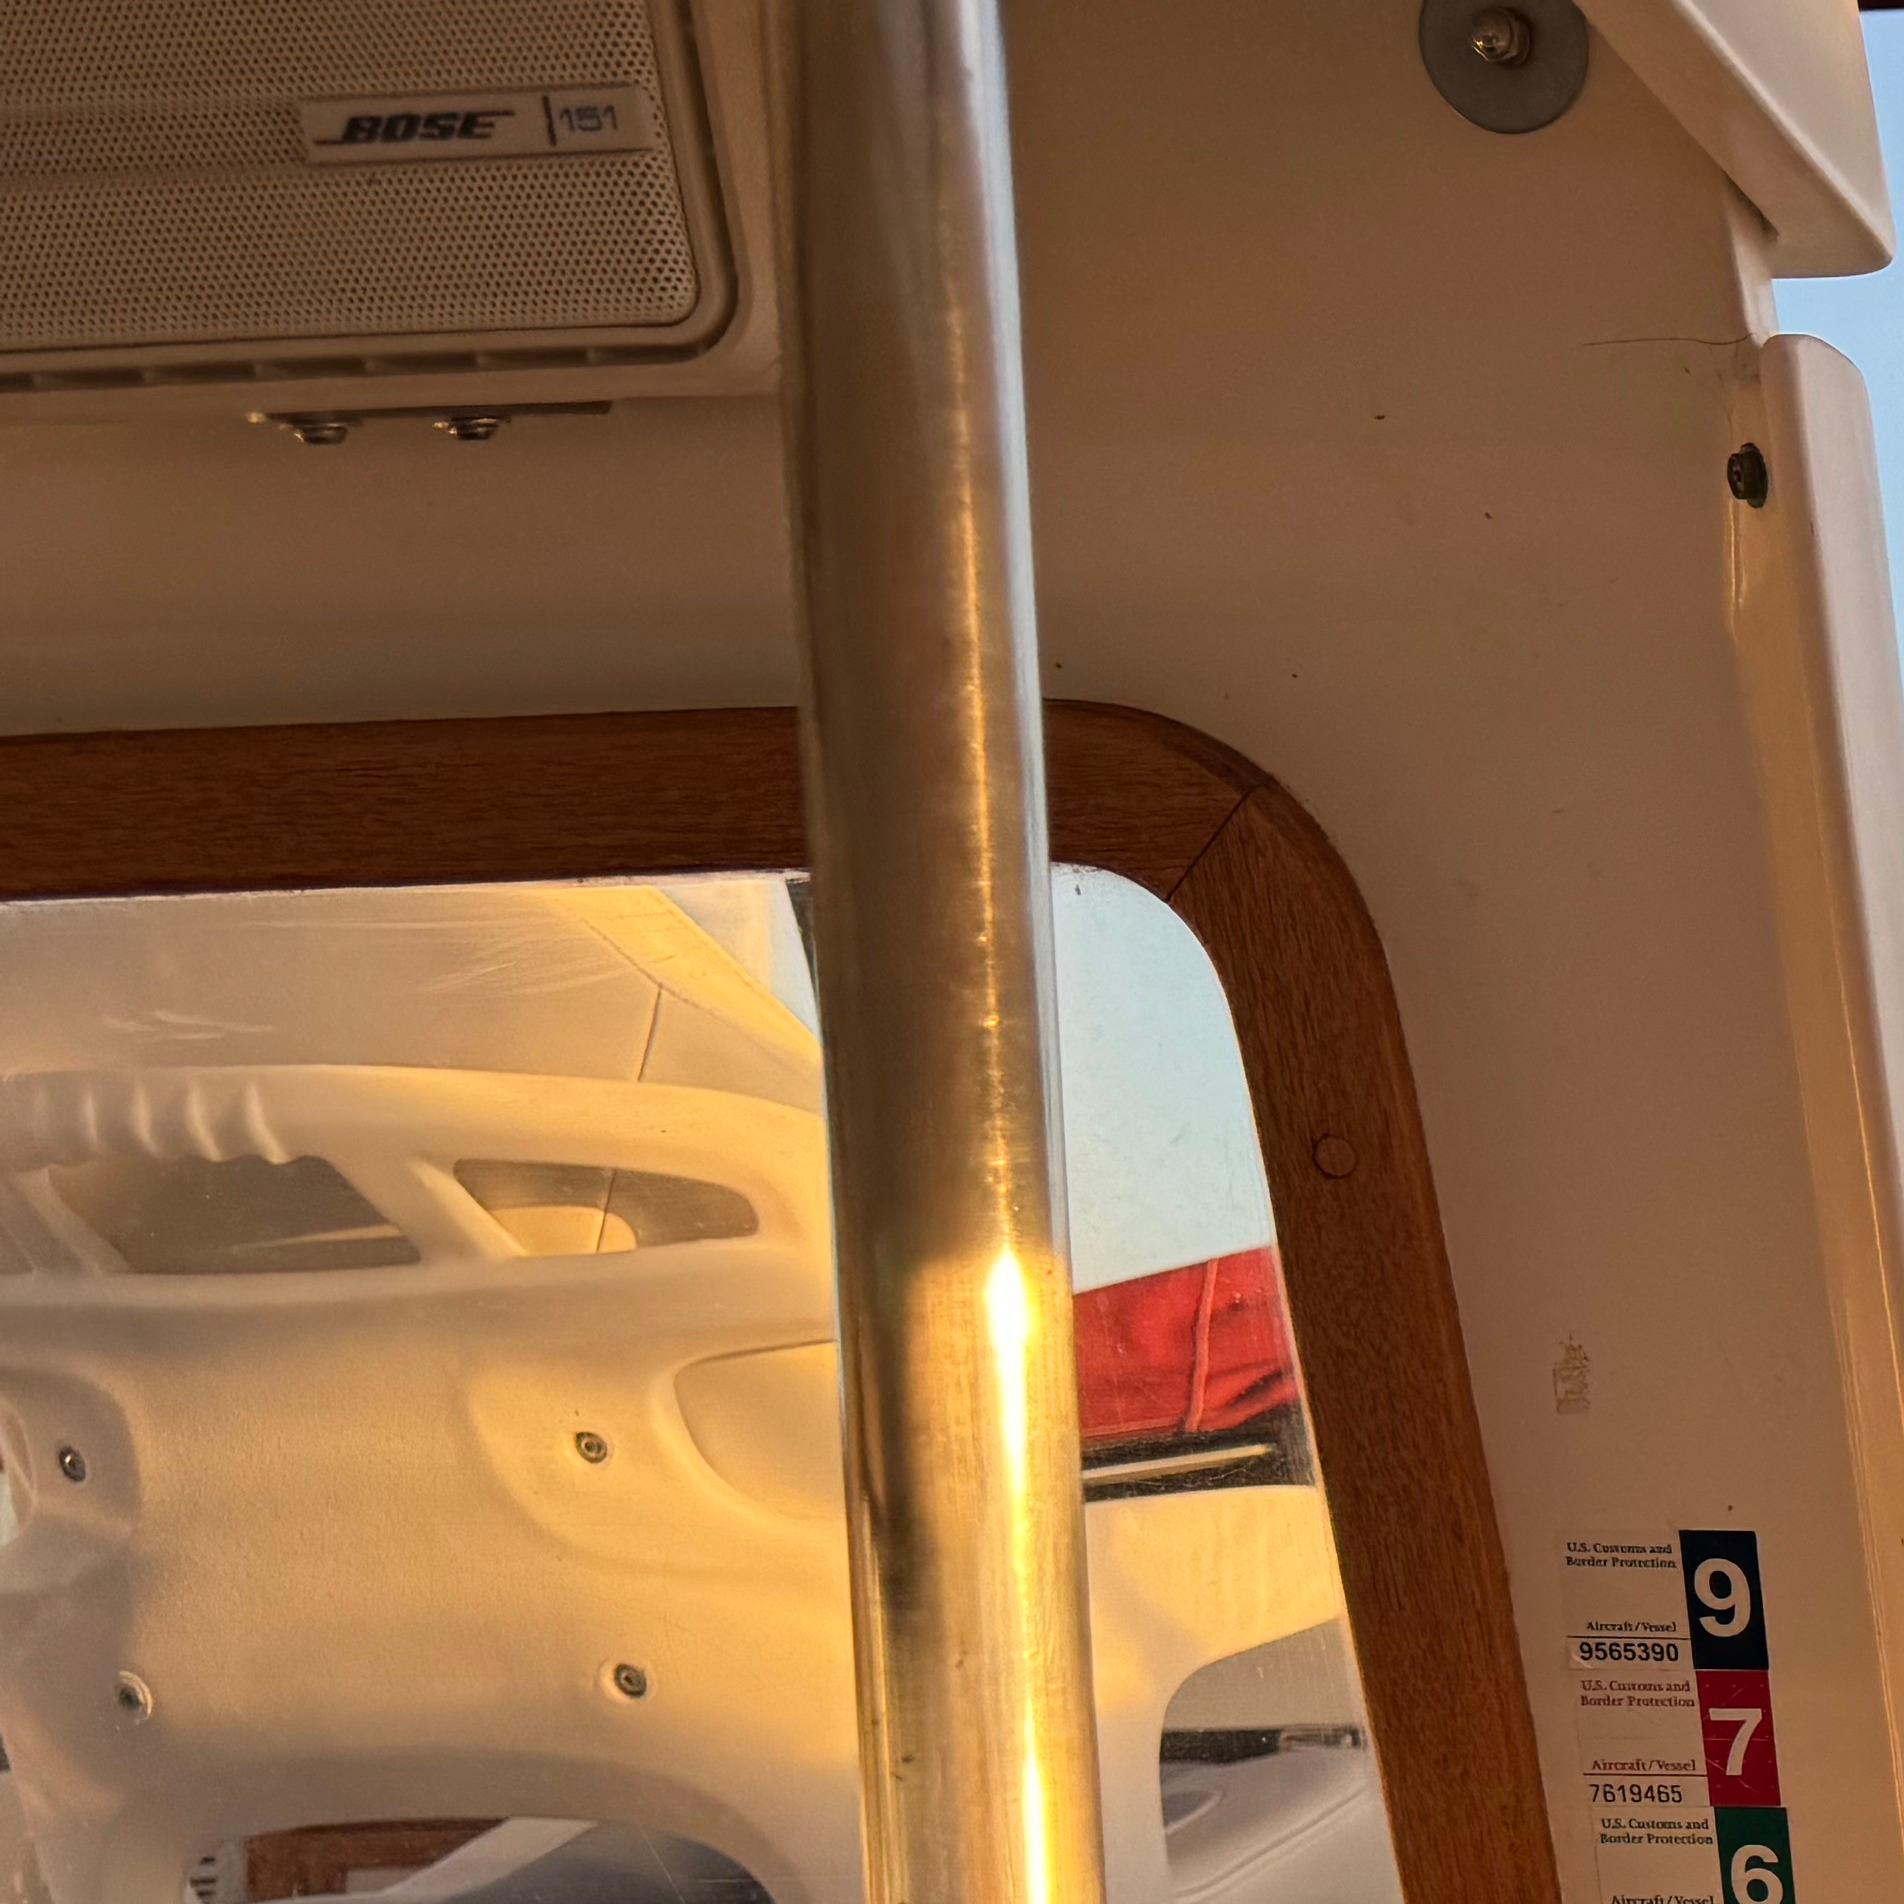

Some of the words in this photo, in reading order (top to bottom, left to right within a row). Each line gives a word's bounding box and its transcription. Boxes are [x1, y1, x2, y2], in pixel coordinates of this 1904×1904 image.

[313, 110, 515, 145] BOSE
[559, 104, 619, 133] 151
[1566, 1542, 1589, 1553] U.S.
[1593, 1543, 1647, 1554] Customs
[1650, 1544, 1673, 1554] and
[1566, 1557, 1608, 1568] Border
[1612, 1556, 1677, 1568] Protection
[1694, 1558, 1751, 1637] 9
[1579, 1642, 1679, 1662] 9565390
[1581, 1680, 1607, 1691] U.S.
[1609, 1680, 1663, 1692] Customs
[1665, 1680, 1690, 1692] and
[1580, 1695, 1623, 1707] Border
[1627, 1696, 1695, 1707] Protection
[1709, 1708, 1762, 1776] 7
[1589, 1783, 1682, 1803] 7619465
[1601, 1818, 1626, 1829] U.S.
[1629, 1818, 1683, 1830] Customs
[1685, 1818, 1709, 1830] and
[1600, 1833, 1643, 1845] Border
[1647, 1834, 1713, 1846] Protection
